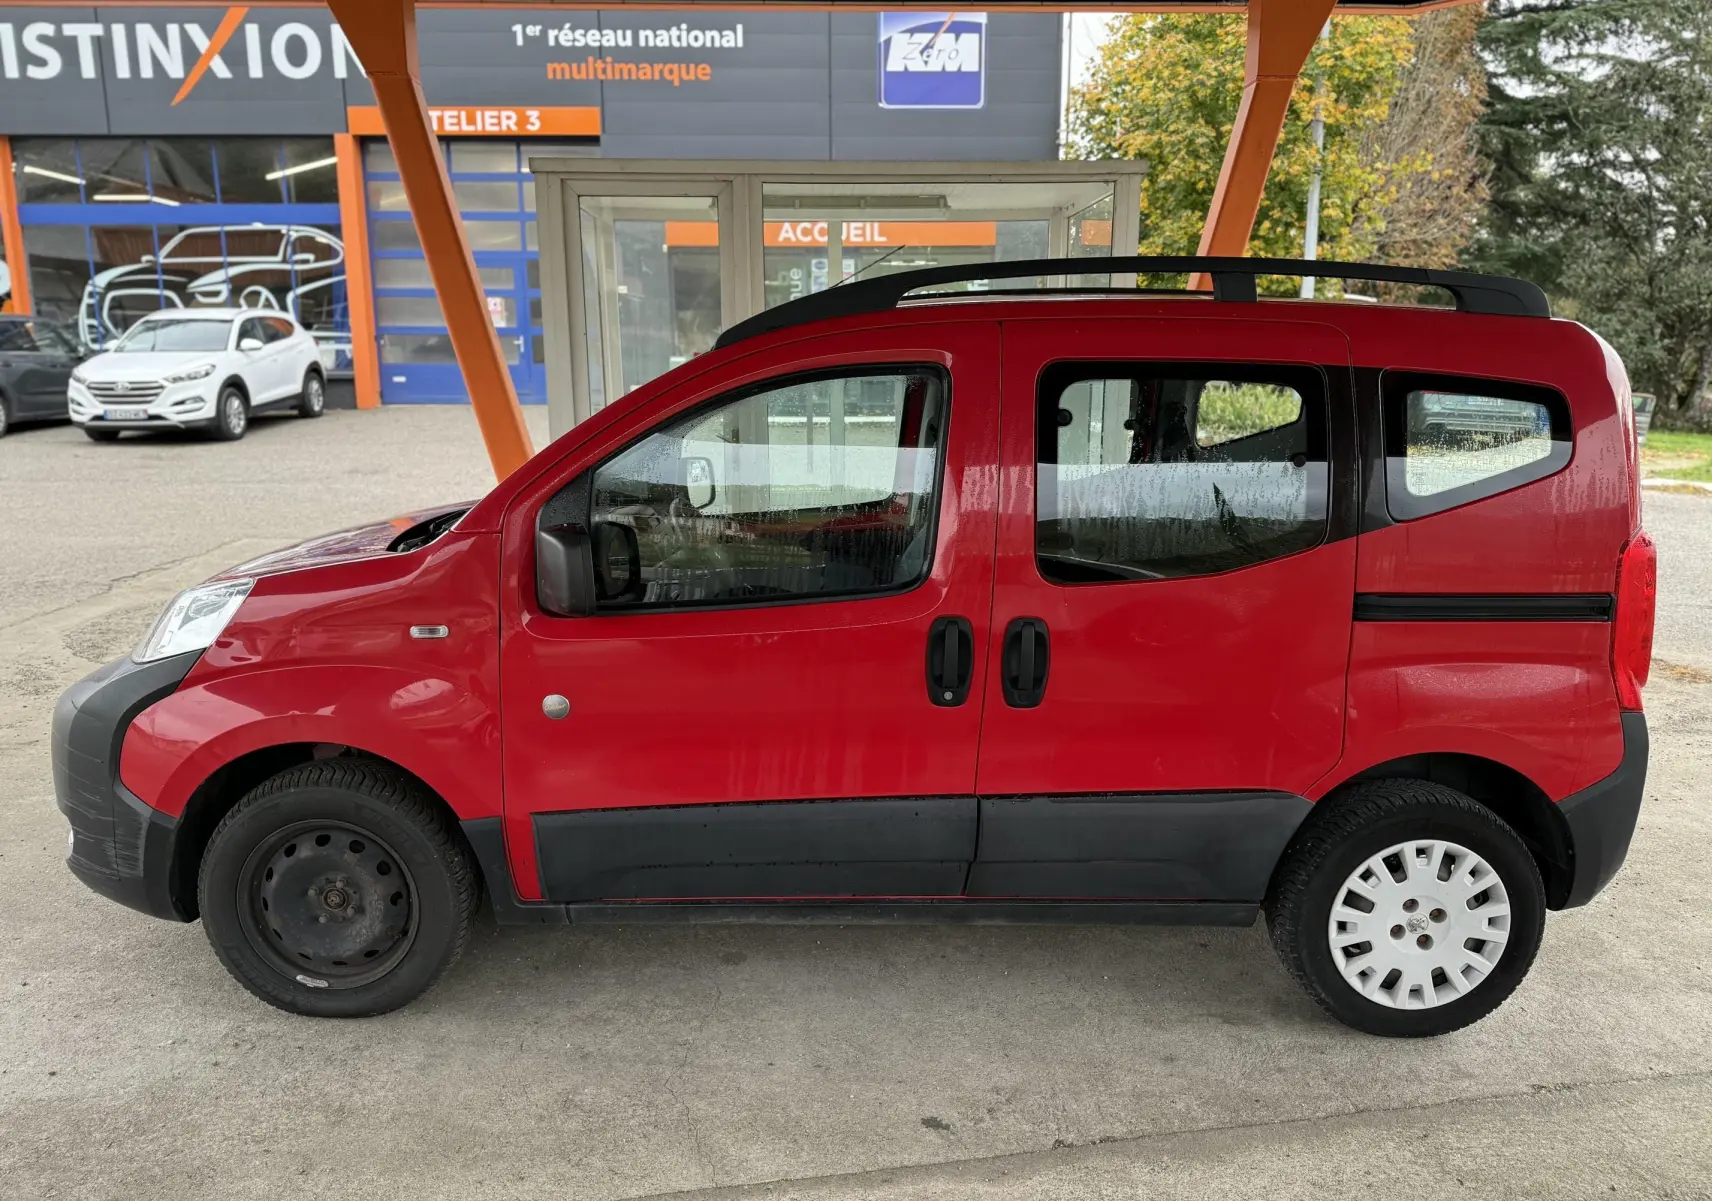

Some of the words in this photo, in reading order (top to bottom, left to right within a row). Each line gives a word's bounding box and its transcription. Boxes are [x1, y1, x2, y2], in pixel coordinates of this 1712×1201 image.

[511, 23, 542, 46] 1er
[547, 23, 632, 47] réseau
[638, 23, 744, 48] national
[546, 56, 712, 87] multimarque
[525, 110, 541, 132] 3
